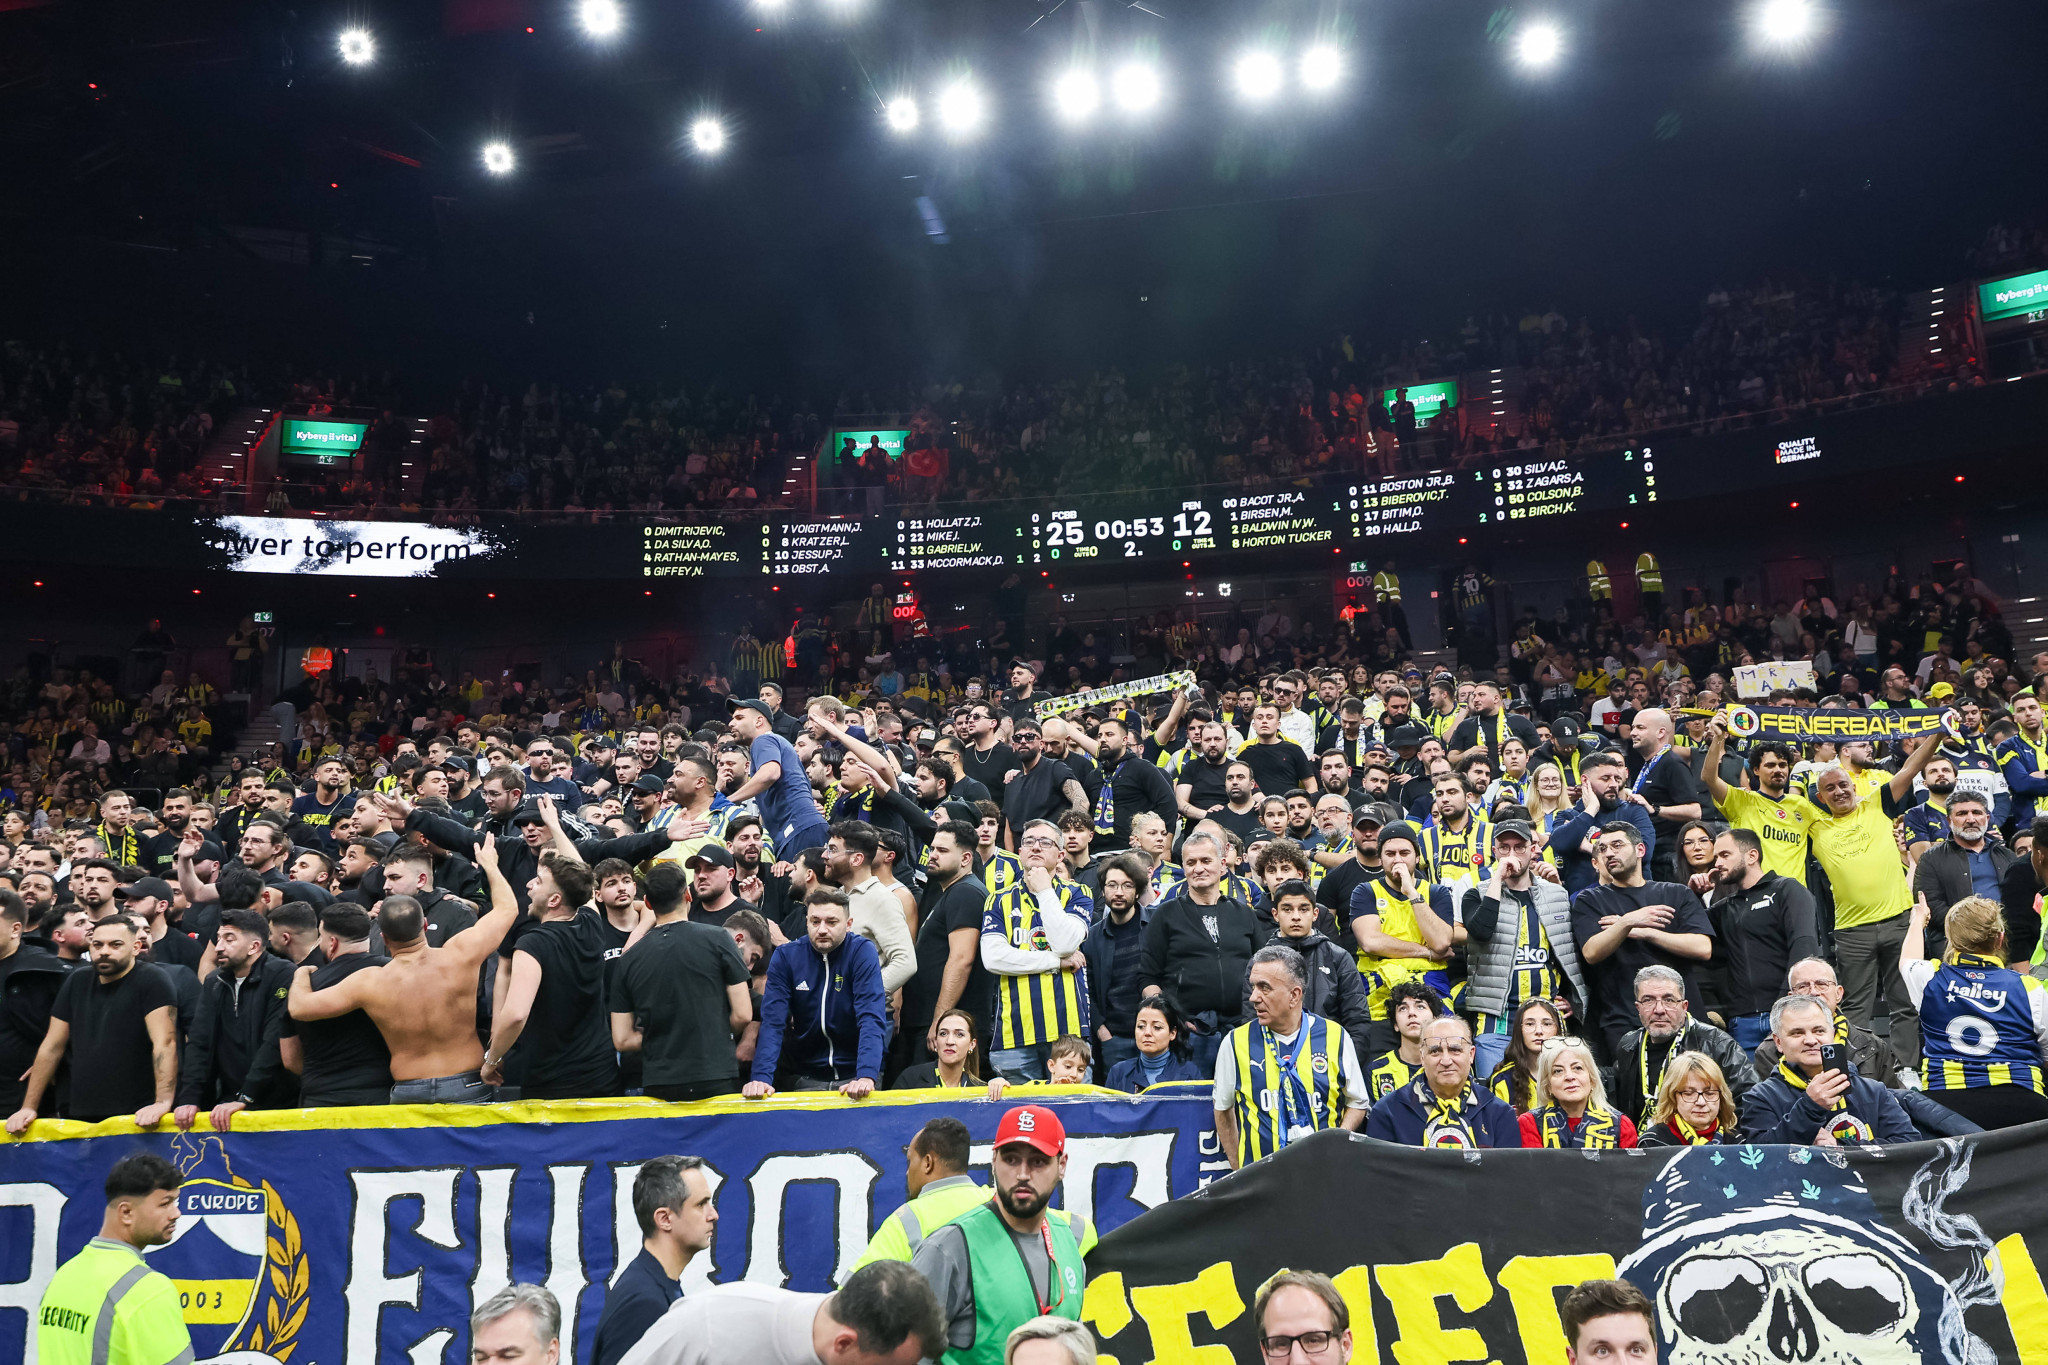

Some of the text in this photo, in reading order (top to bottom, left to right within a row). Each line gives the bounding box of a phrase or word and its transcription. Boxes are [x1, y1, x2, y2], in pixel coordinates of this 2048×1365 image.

[1995, 286, 2035, 304] Kyberg
[296, 431, 357, 442] Kyberg vital
[882, 440, 900, 448] vital
[1778, 437, 1815, 450] QUALITY
[1780, 446, 1804, 456] MADE
[1780, 450, 1821, 463] GERMANY
[1506, 448, 1652, 477] 30 SILVA,C. 2 2
[1362, 484, 1377, 495] 11
[1380, 478, 1423, 493] BOSTON
[1475, 471, 1483, 481] 1
[1492, 469, 1501, 479] 0
[1507, 462, 1653, 491] 32 ZAGARS,A. 0
[1222, 498, 1237, 508] 00
[1239, 494, 1274, 507] BACOT
[1349, 486, 1357, 496] 0
[1363, 482, 1502, 508] 13 BIBEROVIC,T. 3
[1508, 476, 1655, 504] 50 COLSON,B. 3
[1182, 501, 1202, 511] FEN
[1230, 499, 1358, 521] 1 BIRSEN,M. 1 0
[1364, 496, 1503, 522] 17 BITIM,O. 0
[1510, 491, 1656, 519] 92 BIRCH,K. 1 2
[910, 514, 1040, 529] 21 HOLLATZ,J. 0
[1051, 510, 1078, 520] FCBB
[644, 525, 770, 537] 0 DIMITRIJEVIC, 0
[782, 521, 905, 534] 7 VOIGTMANN,J. 0
[1094, 517, 1164, 540] 00:53
[1172, 511, 1212, 537] 12
[1231, 525, 1239, 534] 2
[1241, 521, 1289, 534] BALDWIN
[1351, 513, 1359, 523] 0
[1365, 511, 1505, 536] 20 HALL,D. 2 0
[782, 534, 905, 547] 8 KRATZER,L. 0
[910, 527, 1040, 543] 22 MIKE,I. 1 3
[1046, 520, 1084, 546] 25
[1232, 527, 1360, 548] 8 HORTON TUCKER 2
[303, 536, 332, 558] to
[346, 536, 471, 563] perform
[644, 538, 770, 550] 1 DA SILVA,O. 0
[910, 540, 1040, 556] 32 GABRIEL,W. 0
[1051, 548, 1060, 559] 0
[1089, 545, 1098, 557] 0
[1124, 541, 1144, 557] 2.
[1172, 540, 1181, 551] 0
[1207, 537, 1216, 548] 1
[1192, 542, 1208, 550] OUTS
[644, 551, 769, 562] 4 RATHAN-MAYES, 1
[775, 547, 906, 560] 10 JESSUP,J. 1 4
[910, 554, 1040, 569] 33 MCCORMACK,D. 1 2
[644, 565, 770, 577] 5 GIFFEY,N. 4
[775, 561, 905, 574] 13 OBST,A. 11
[1347, 575, 1373, 588] 009
[1463, 578, 1480, 593] 10
[1741, 667, 1788, 680] MERT
[1760, 713, 1941, 738] FENERBAHÇE
[1763, 824, 1801, 847] Otokoç
[1516, 946, 1548, 963] eko
[187, 1194, 259, 1211] EUROPE
[180, 1290, 223, 1310] 003
